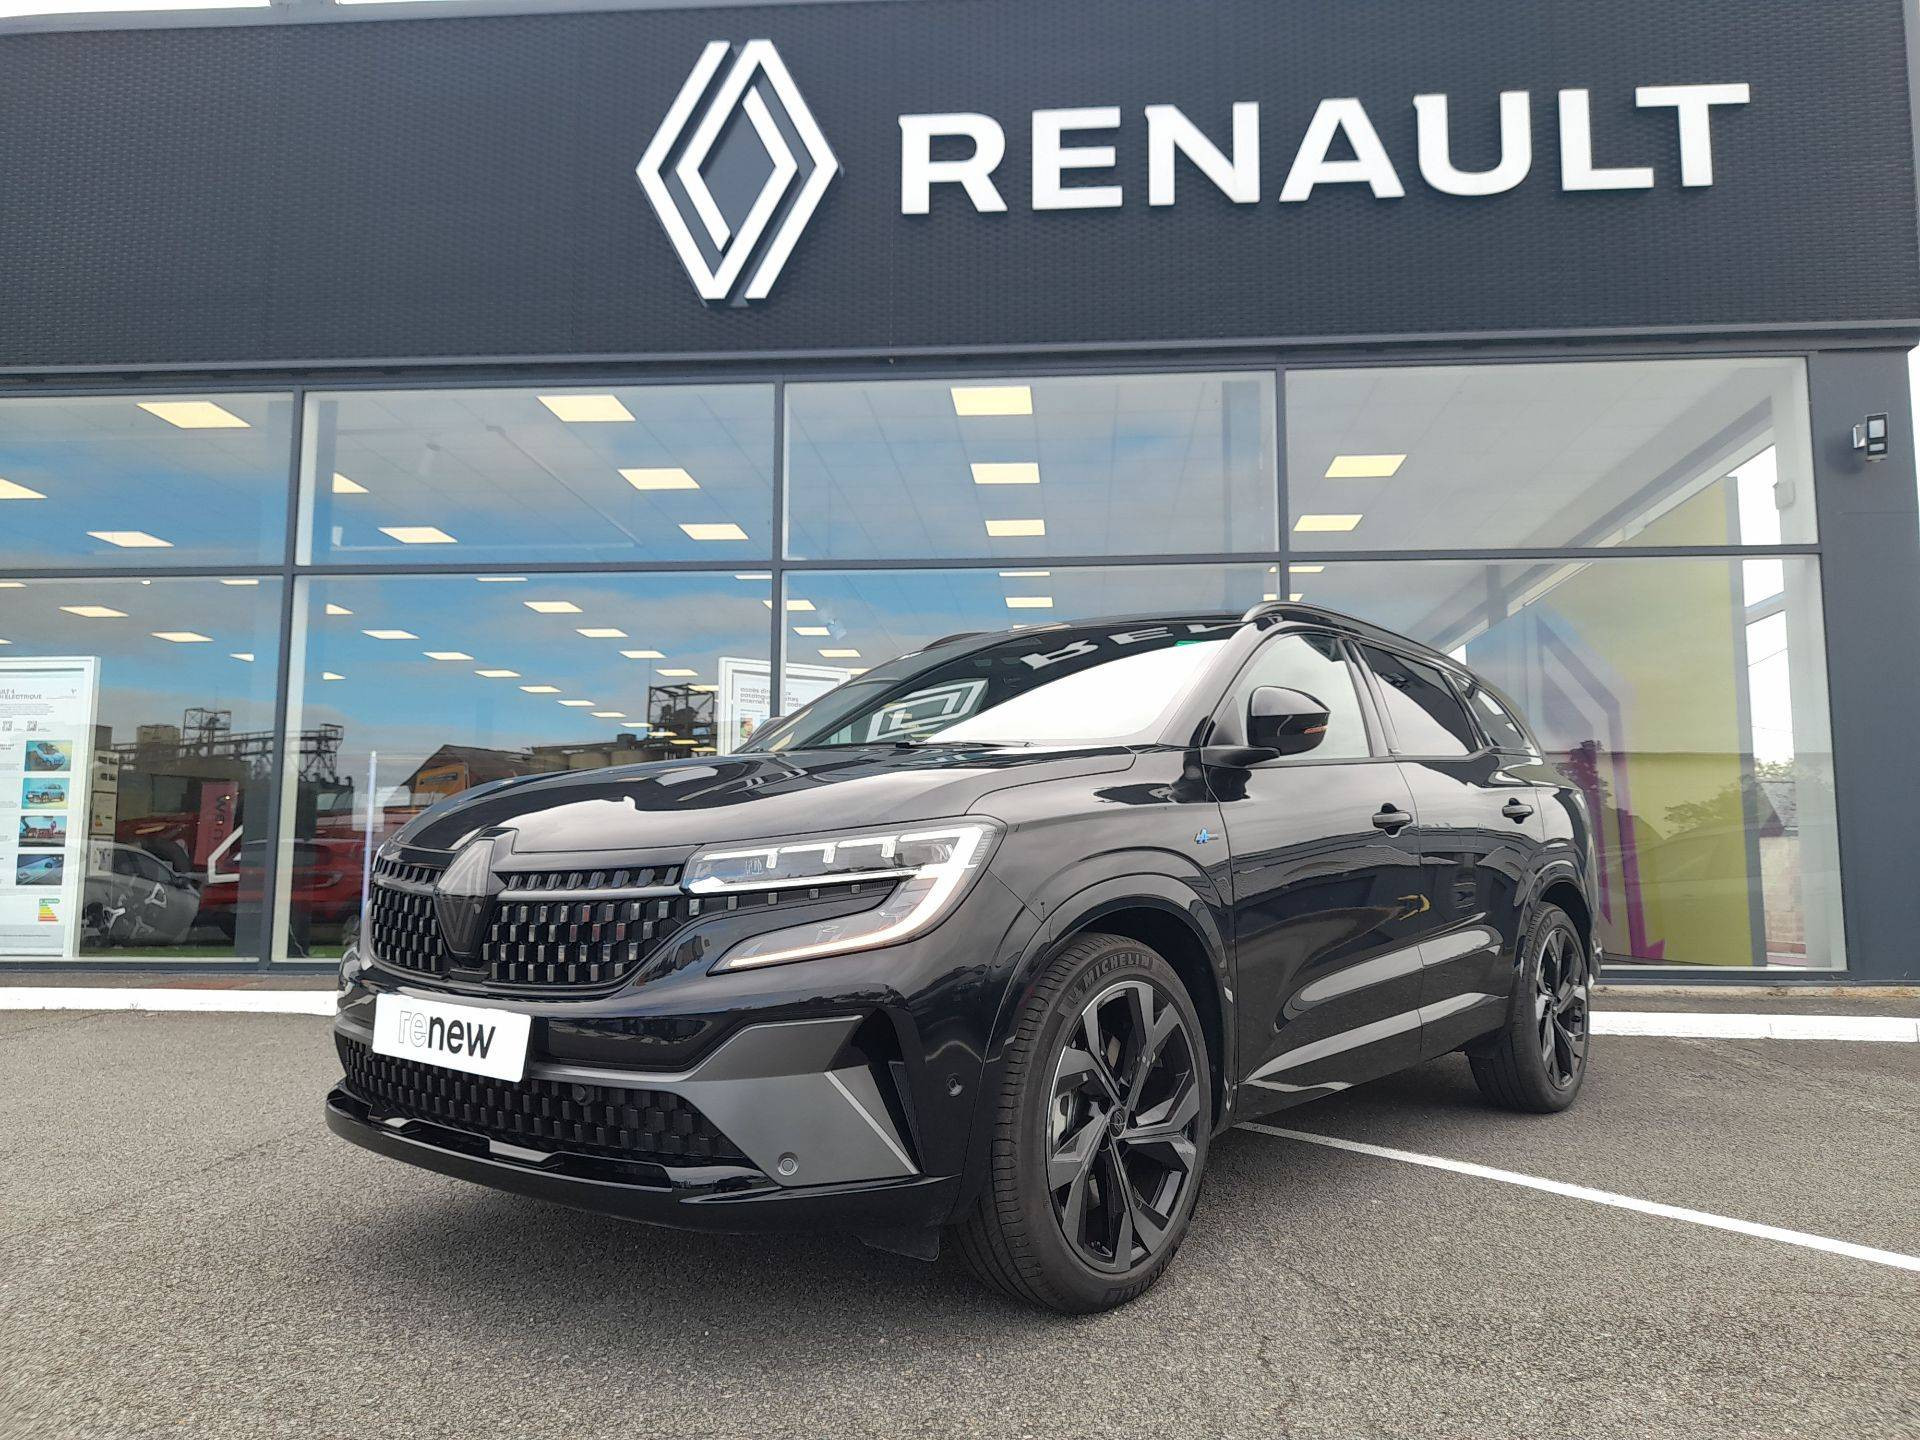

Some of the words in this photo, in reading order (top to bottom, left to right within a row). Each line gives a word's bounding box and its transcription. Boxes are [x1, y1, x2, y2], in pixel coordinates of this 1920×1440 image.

[897, 82, 1751, 215] RENAULT
[1081, 952, 1152, 990] MICHELIN
[398, 1010, 496, 1060] renew
